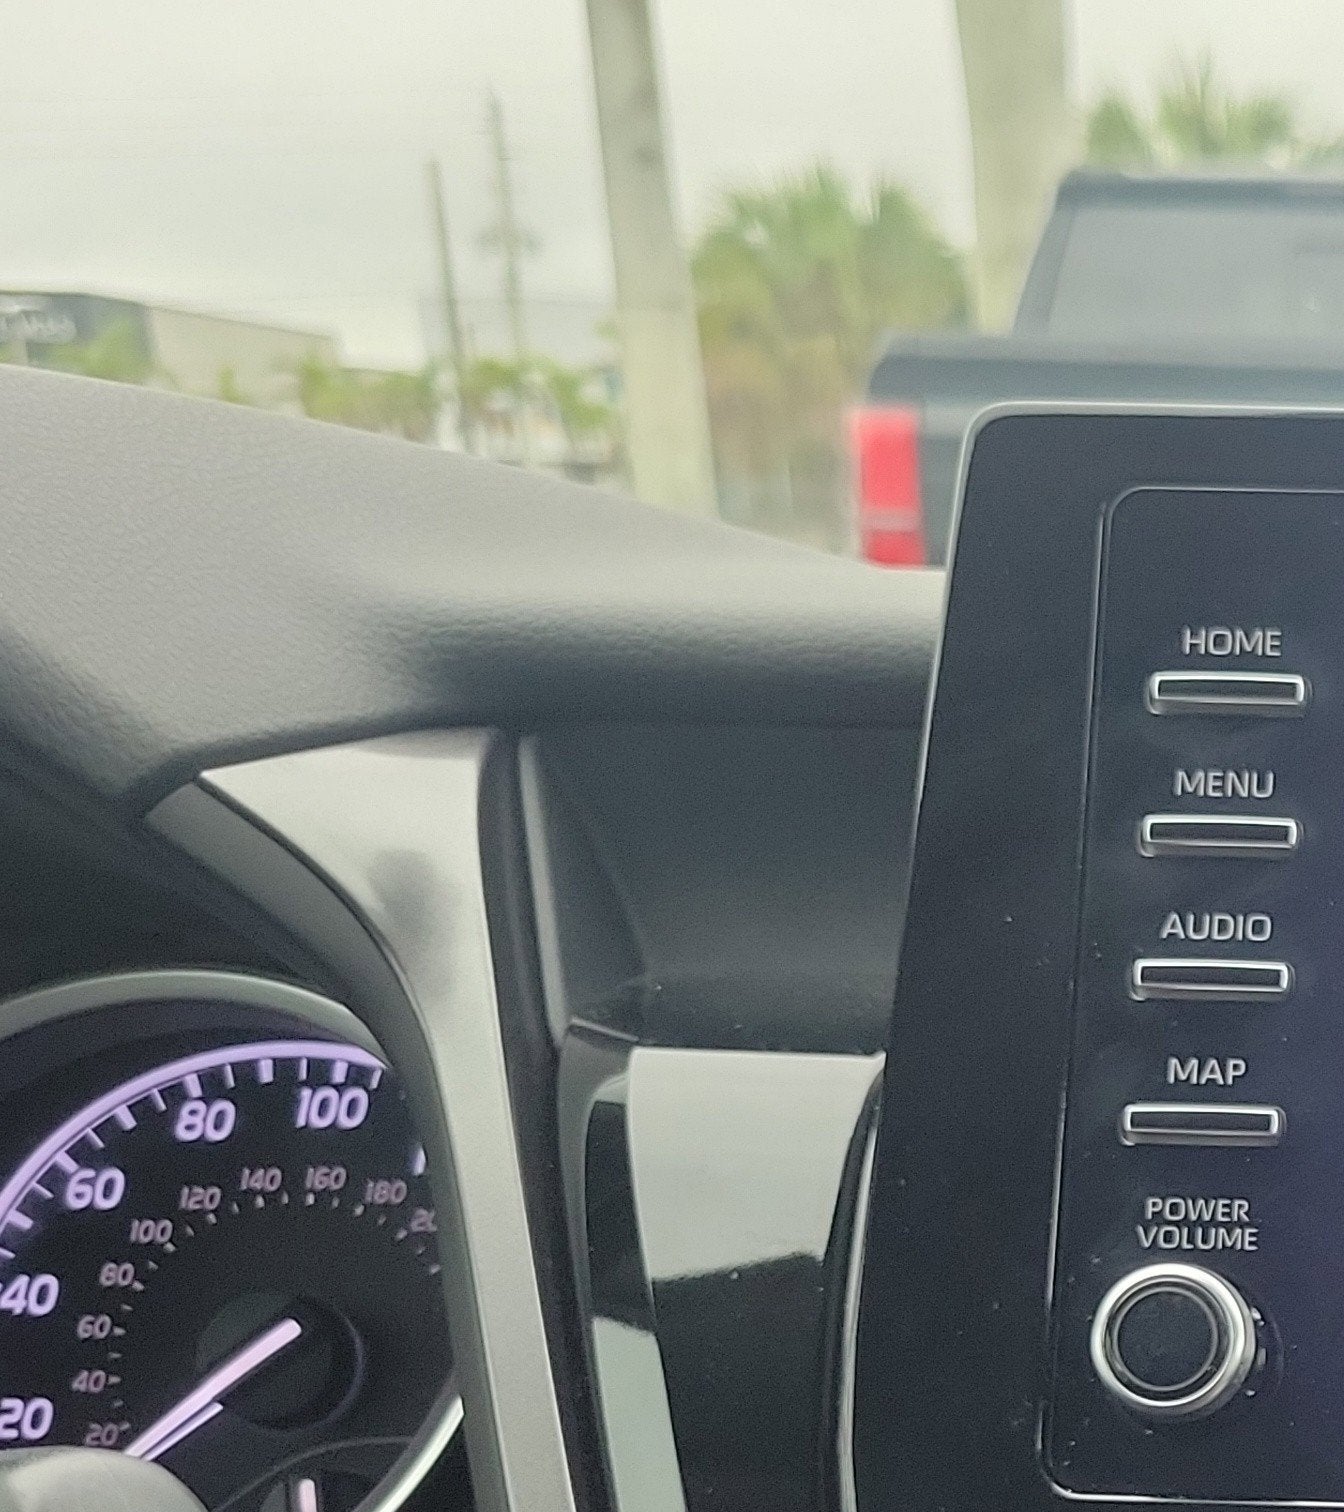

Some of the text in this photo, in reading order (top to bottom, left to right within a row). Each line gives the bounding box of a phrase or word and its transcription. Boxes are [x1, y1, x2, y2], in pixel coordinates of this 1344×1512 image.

[1180, 627, 1284, 657] HOME
[1173, 768, 1276, 800] MENU
[1159, 912, 1274, 944] AUDIO
[1166, 1057, 1248, 1086] MAP
[174, 1099, 236, 1142] 80
[296, 1086, 370, 1129] 100
[66, 1167, 126, 1210] 60
[240, 1166, 283, 1193] 140
[305, 1166, 348, 1192] 160
[365, 1180, 408, 1205] 180
[180, 1185, 222, 1212] 120
[1144, 1197, 1251, 1222] POWER
[130, 1218, 173, 1245] 100
[1136, 1225, 1259, 1251] VOLUME
[101, 1262, 134, 1287] 80
[77, 1314, 112, 1339] 60
[72, 1370, 105, 1393] 40
[0, 1397, 54, 1440] 20
